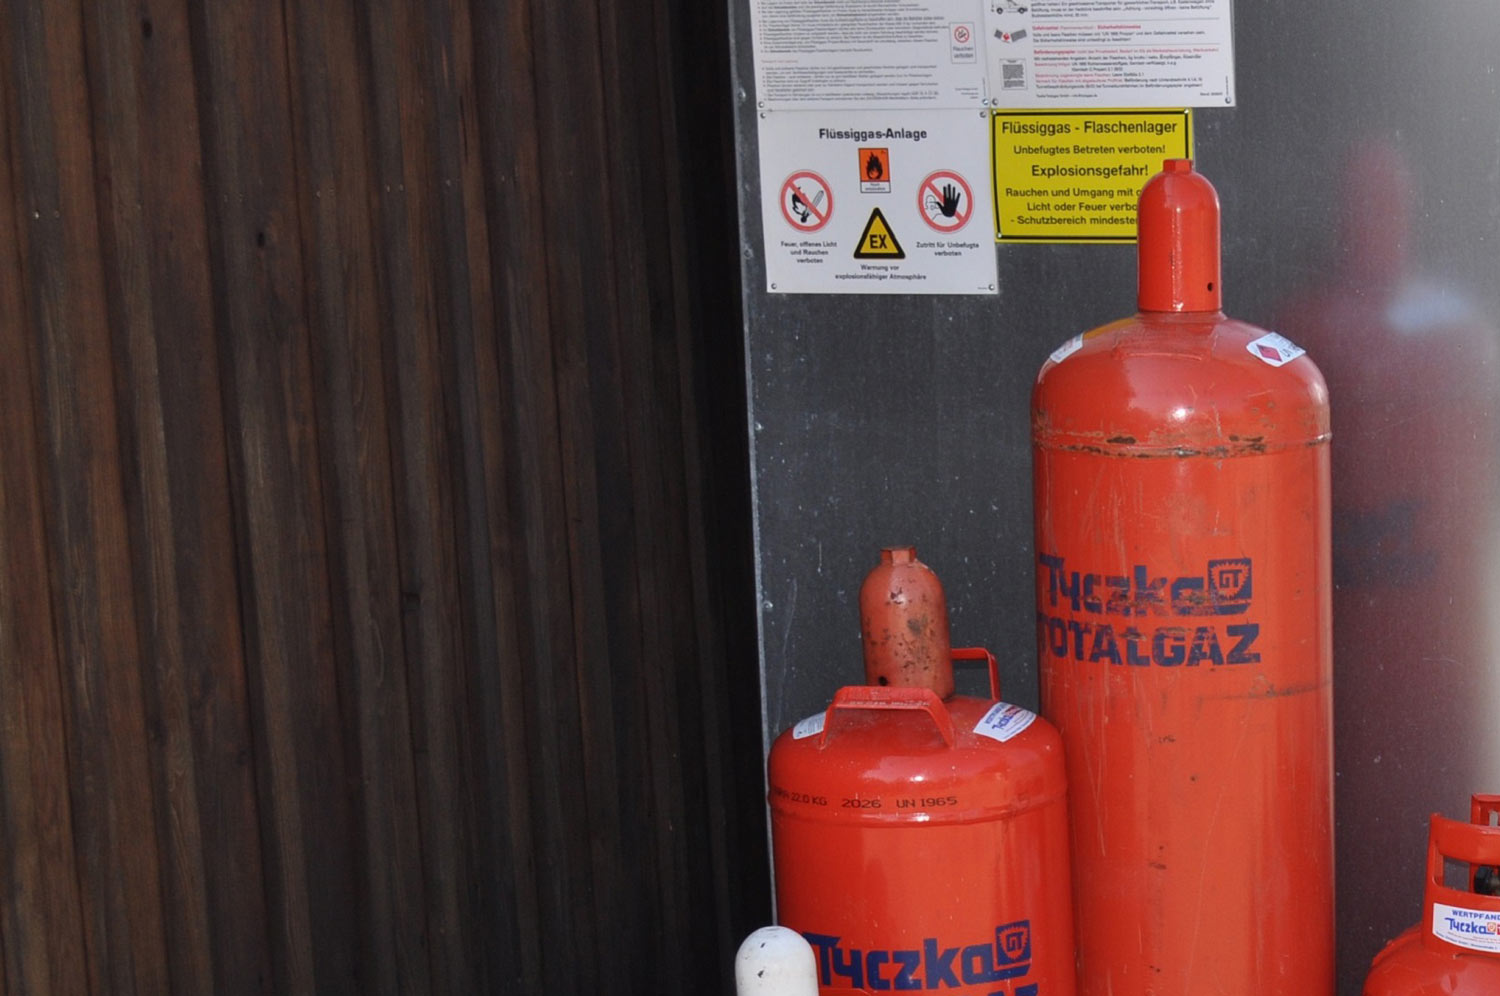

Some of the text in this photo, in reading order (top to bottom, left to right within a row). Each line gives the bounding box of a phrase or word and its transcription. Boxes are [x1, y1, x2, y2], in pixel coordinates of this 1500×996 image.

[818, 127, 928, 142] Flüssiggas-Anlage
[1002, 121, 1071, 136] Flüssiggas
[1084, 120, 1178, 136] Flaschenlager
[1013, 144, 1166, 155] Unbefugtes Betreten verboten!
[1031, 164, 1149, 178] Explosionsgefahr!
[1006, 188, 1049, 197] Rauchen
[1051, 188, 1070, 197] und
[1073, 188, 1114, 199] Umgang
[1117, 188, 1134, 197] mit
[1027, 202, 1137, 212] Licht oder Feuer verbo
[1017, 216, 1087, 225] Schutzbereich
[1089, 216, 1138, 225] mindeste
[869, 234, 888, 250] EX
[947, 241, 980, 250] Unbefugte
[860, 264, 888, 273] Warnung
[835, 273, 927, 281] explosionsfähiger Atmosphäre
[1039, 552, 1210, 617] Tyczka
[841, 797, 882, 809] 2026
[896, 798, 916, 809] UN
[920, 795, 958, 808] 1965
[1444, 917, 1490, 935] Tyczka
[802, 930, 998, 991] Tyczka
